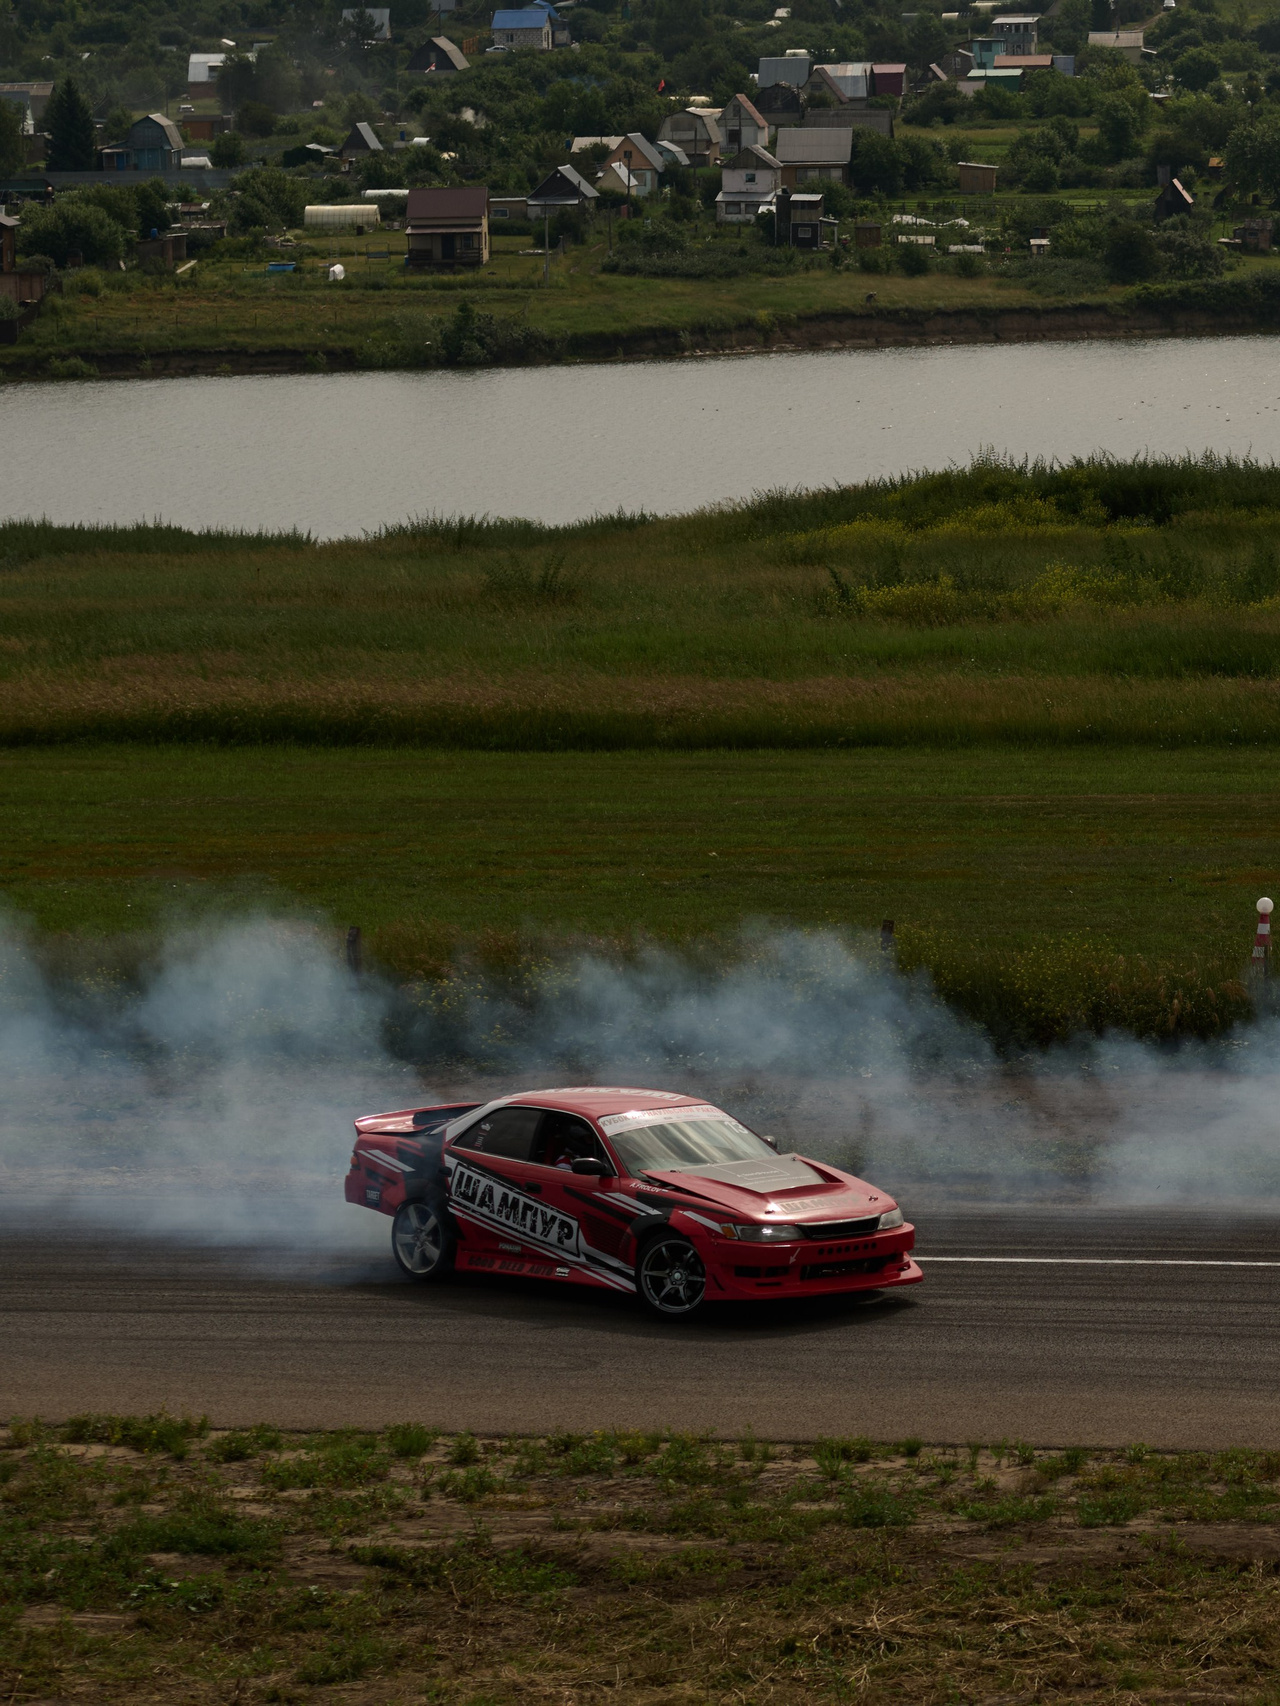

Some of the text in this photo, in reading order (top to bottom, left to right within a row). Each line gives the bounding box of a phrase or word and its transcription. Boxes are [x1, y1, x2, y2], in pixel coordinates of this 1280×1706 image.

[600, 1115, 630, 1127] КУБОК
[632, 1107, 693, 1120] РНАУЛЬСКОЙ
[724, 1121, 749, 1134] 13
[455, 1170, 574, 1245] ШАМПУР
